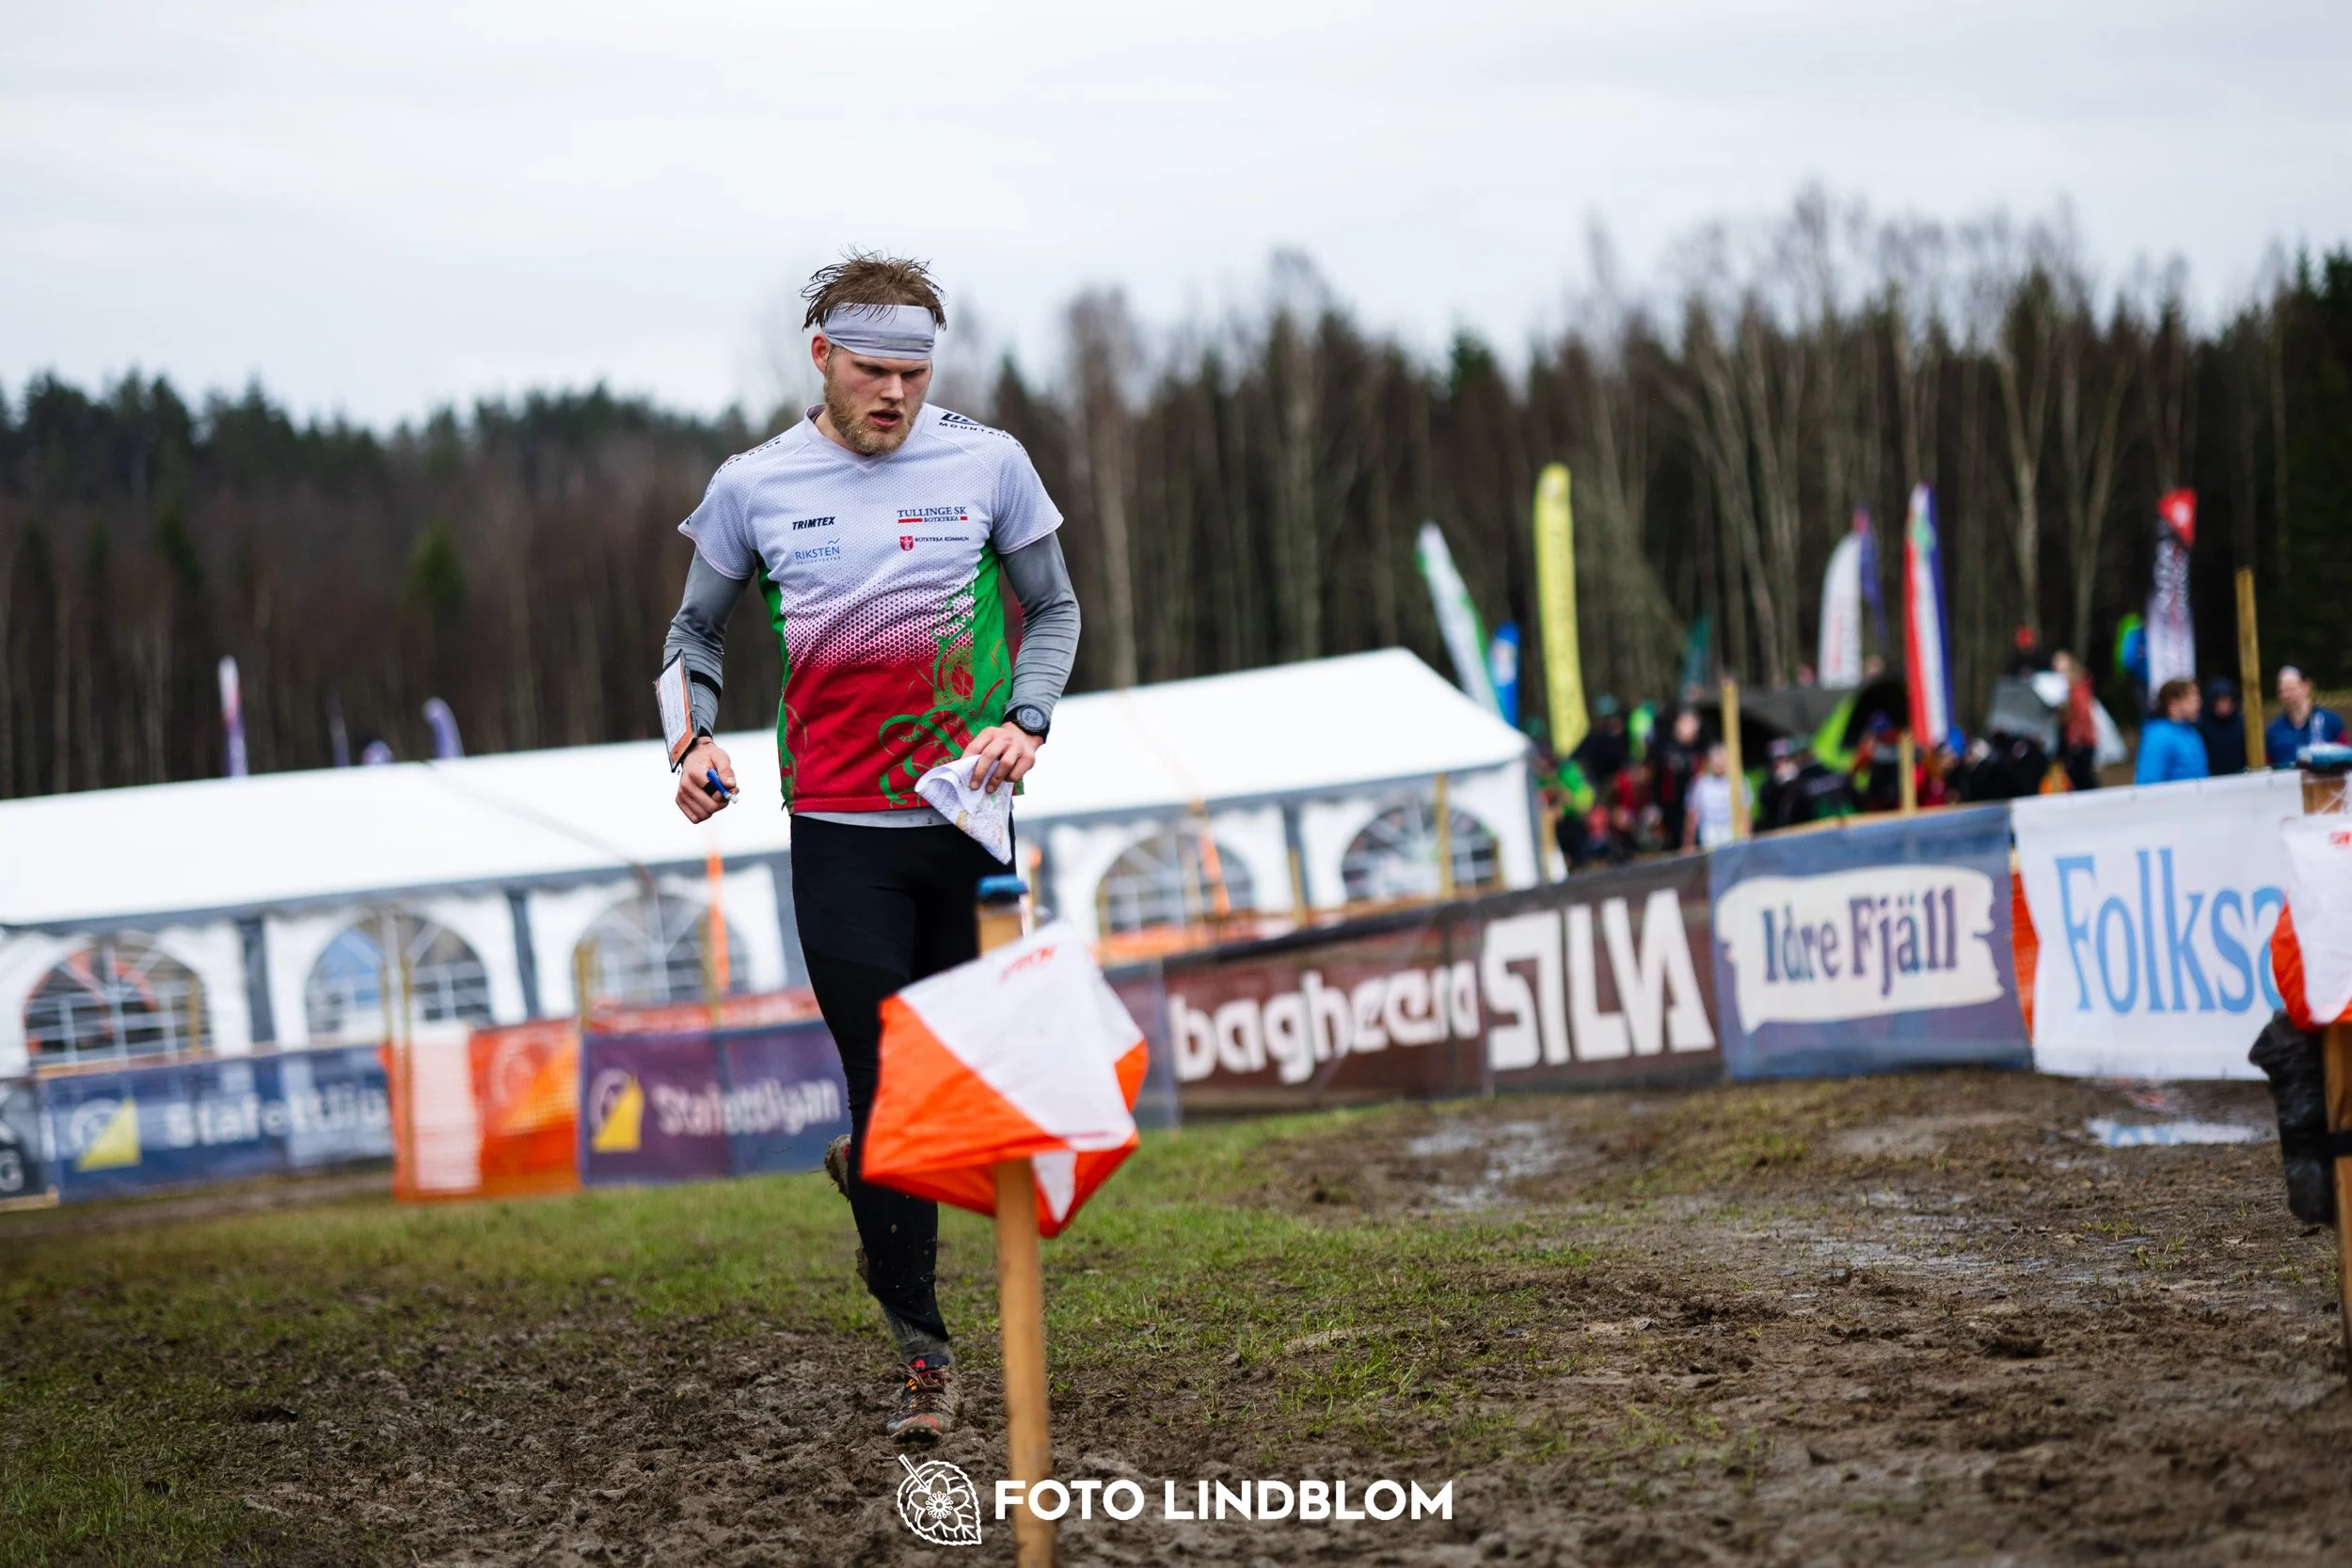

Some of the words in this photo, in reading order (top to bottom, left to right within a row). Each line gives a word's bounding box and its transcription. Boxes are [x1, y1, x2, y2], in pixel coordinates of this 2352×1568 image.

[938, 420, 1009, 440] MOUNTAIN
[897, 507, 953, 517] TULLINGE
[954, 506, 967, 515] SK
[792, 516, 835, 531] TRIMTEX
[795, 546, 840, 561] RIKSTEN
[1762, 902, 1839, 981] Idre
[1849, 884, 1956, 997] Fjäll
[1484, 889, 1716, 1071] SILVA
[1168, 958, 1480, 1084] bagheera
